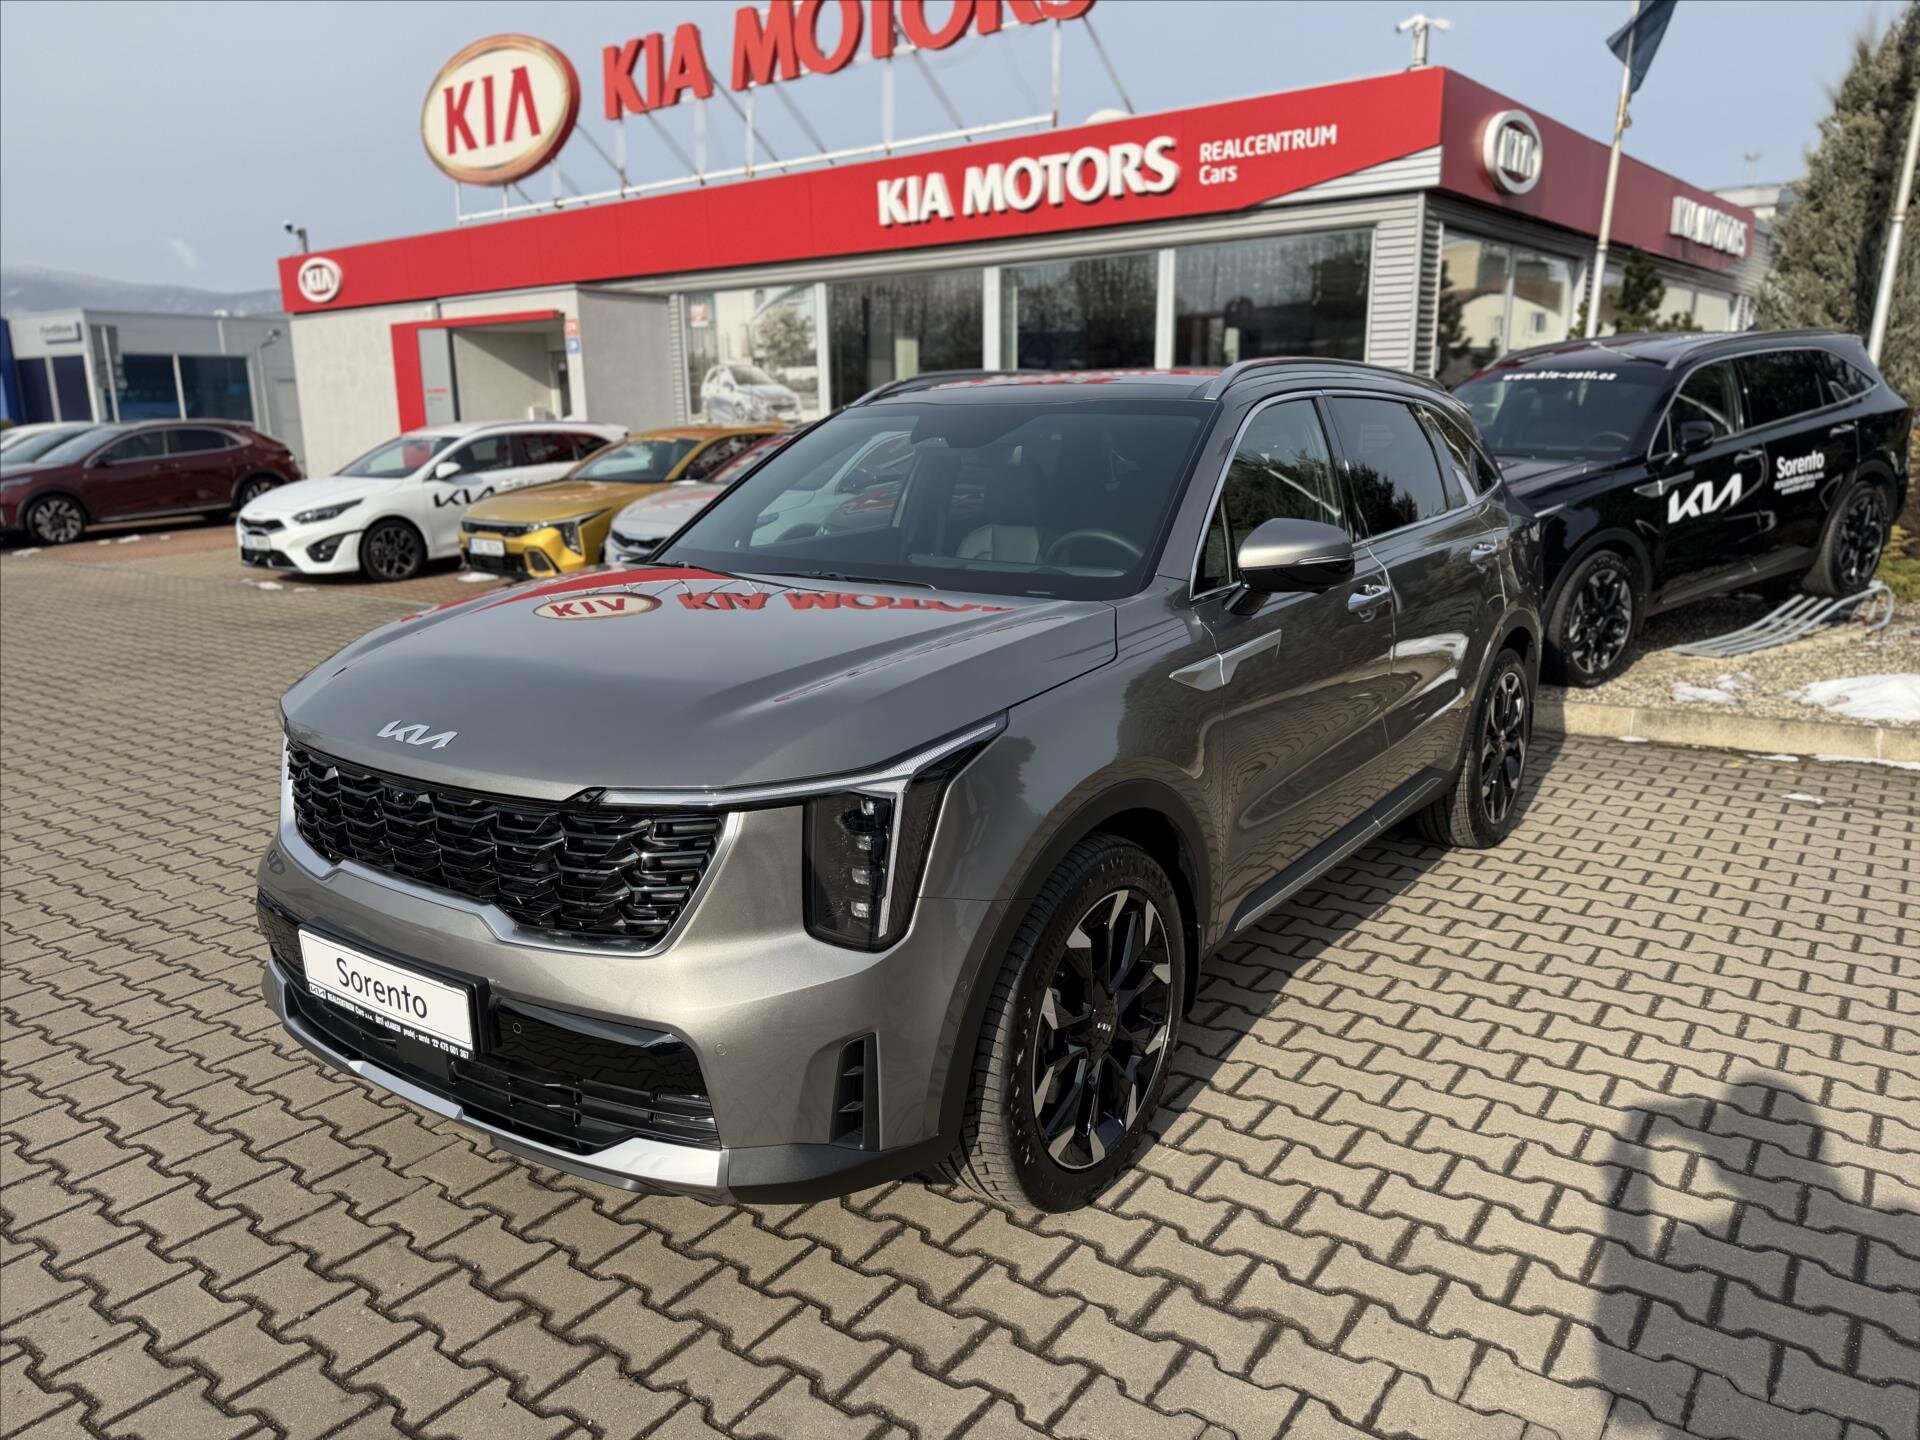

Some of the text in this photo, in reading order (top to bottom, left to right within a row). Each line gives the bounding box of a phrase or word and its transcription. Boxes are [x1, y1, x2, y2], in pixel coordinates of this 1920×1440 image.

[603, 23, 713, 120] KIA
[444, 66, 542, 156] KIA
[1199, 124, 1338, 163] REALCENTRUM
[877, 136, 1180, 227] KIA MOTORS
[1199, 164, 1238, 186] Cars
[304, 267, 333, 291] KIA
[1776, 450, 1825, 479] Sorento
[1667, 473, 1742, 524] KIA
[376, 719, 459, 750] KIA
[336, 957, 428, 1019] Sorento
